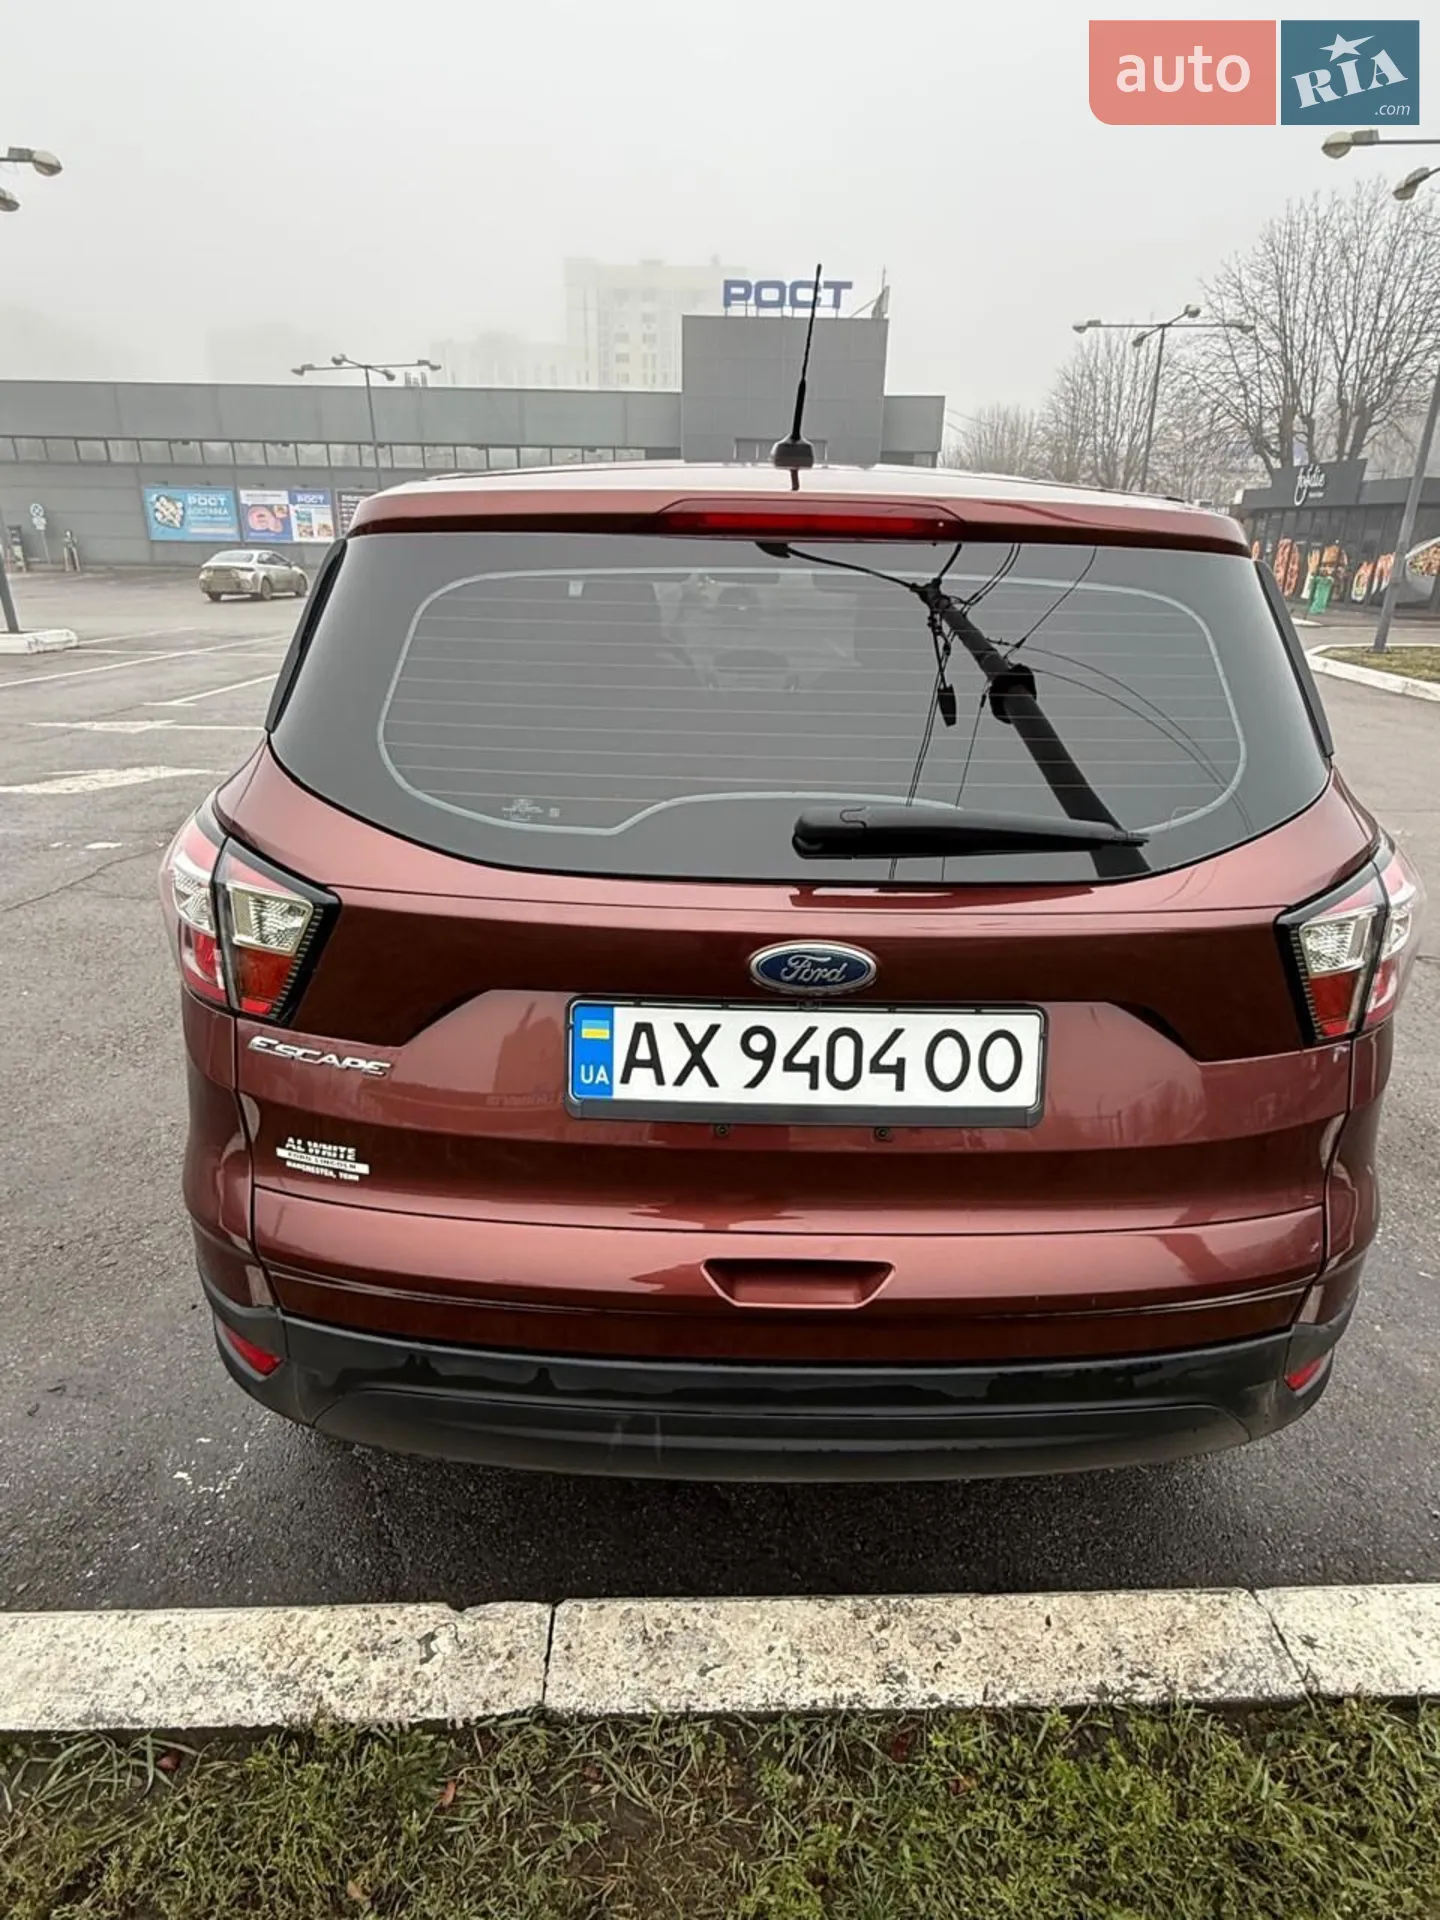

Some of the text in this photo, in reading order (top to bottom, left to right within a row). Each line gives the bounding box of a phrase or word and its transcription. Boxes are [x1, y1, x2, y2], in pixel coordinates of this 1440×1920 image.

[723, 279, 853, 309] РОСТ
[187, 496, 227, 506] РОСТ
[780, 954, 847, 984] Ford
[248, 1035, 393, 1077] ESCAPE
[620, 1021, 1023, 1093] AX 9404 OO
[581, 1064, 610, 1085] UA
[285, 1136, 357, 1161] AL WHITE
